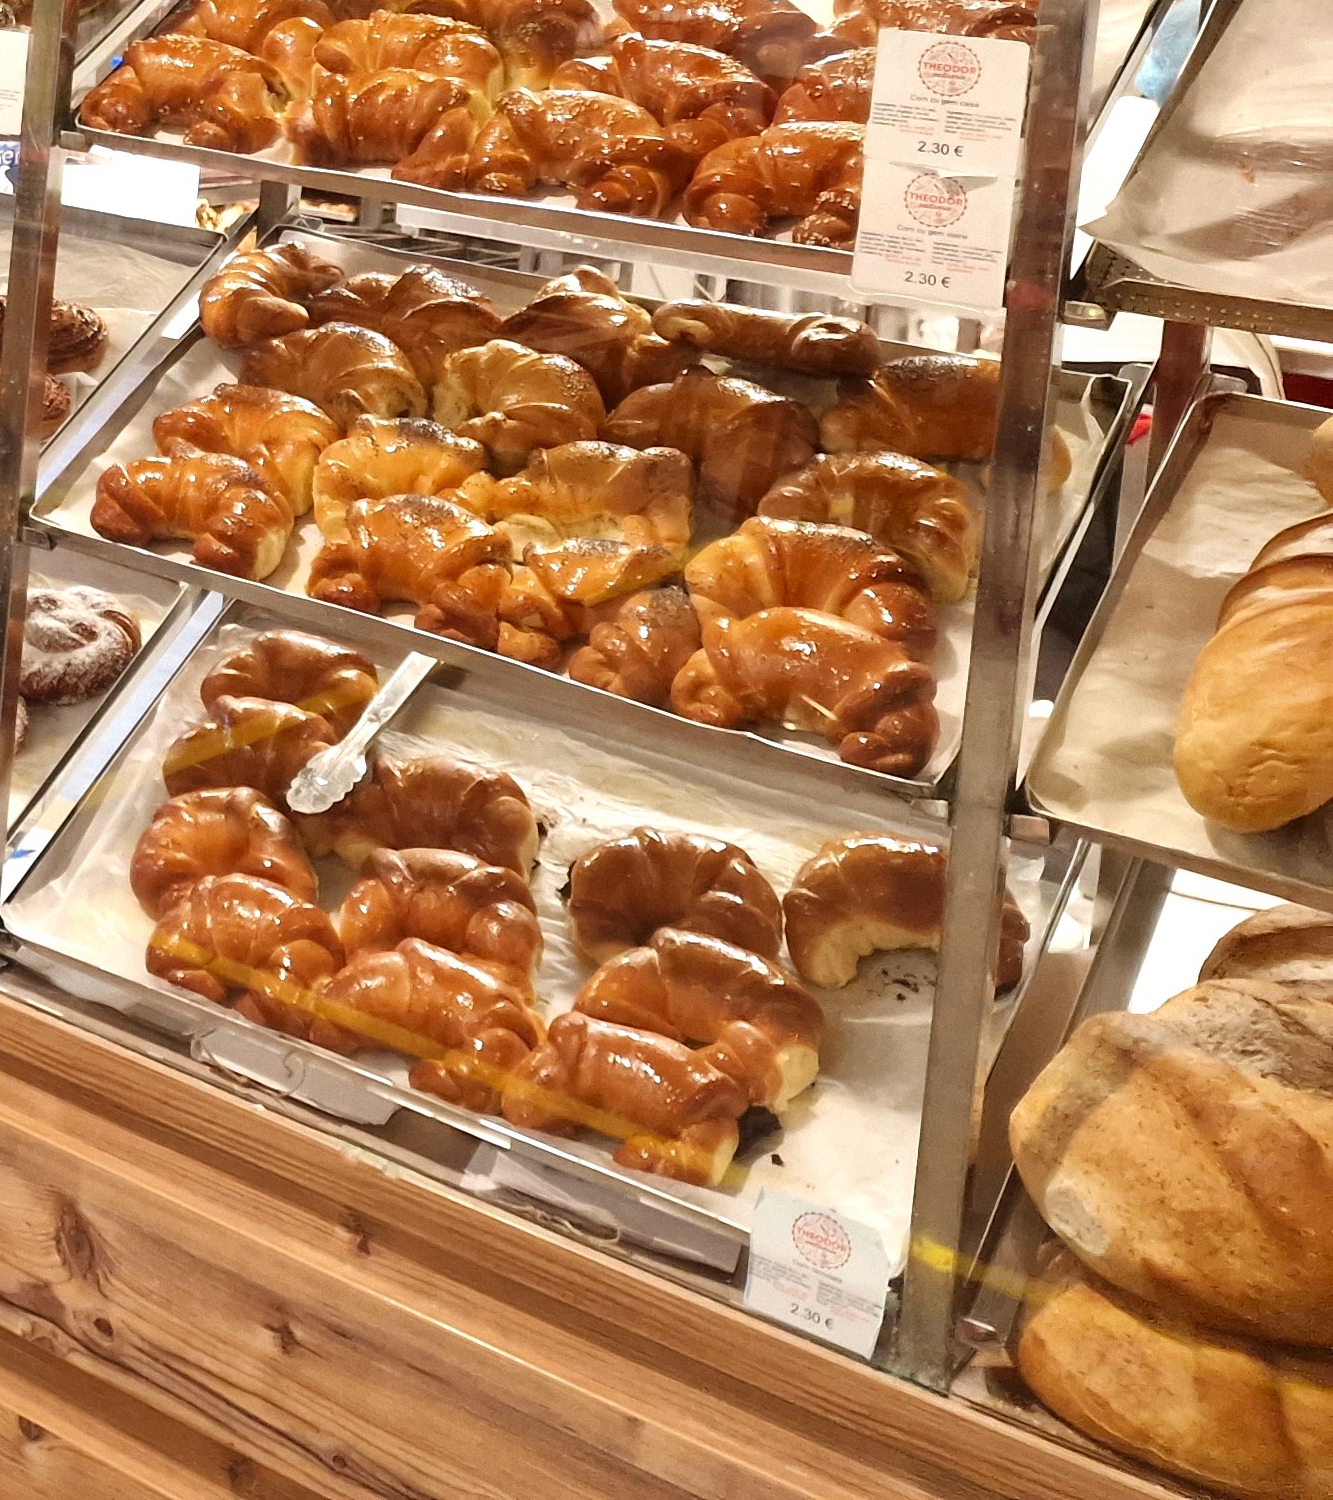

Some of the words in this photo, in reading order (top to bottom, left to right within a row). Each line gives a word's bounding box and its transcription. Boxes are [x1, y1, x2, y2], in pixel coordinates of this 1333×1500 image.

[923, 61, 977, 74] THEODOR
[917, 140, 950, 156] 2.30
[954, 145, 964, 157] €
[909, 192, 963, 207] THEODOR
[904, 270, 937, 286] 2.30
[941, 276, 951, 289] €
[789, 1302, 821, 1325] 2.30
[825, 1317, 835, 1330] €
